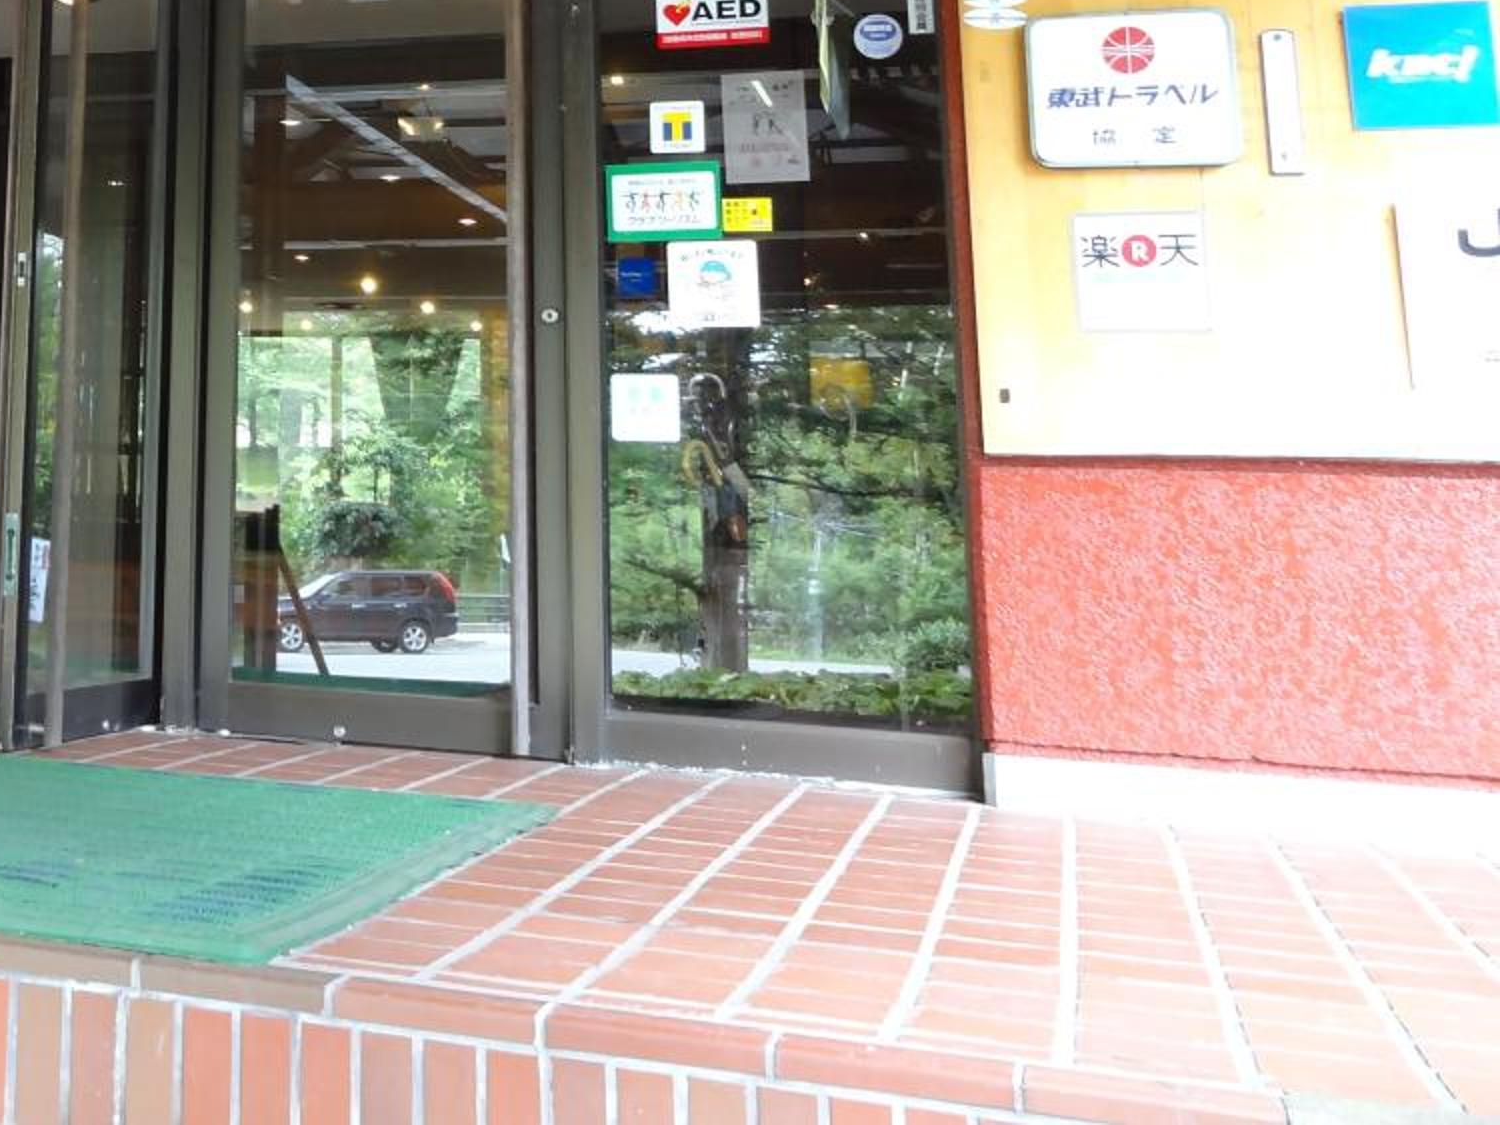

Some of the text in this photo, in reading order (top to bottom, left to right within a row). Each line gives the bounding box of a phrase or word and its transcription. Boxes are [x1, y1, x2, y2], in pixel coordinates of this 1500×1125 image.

[1047, 82, 1219, 110] 東武トラベル
